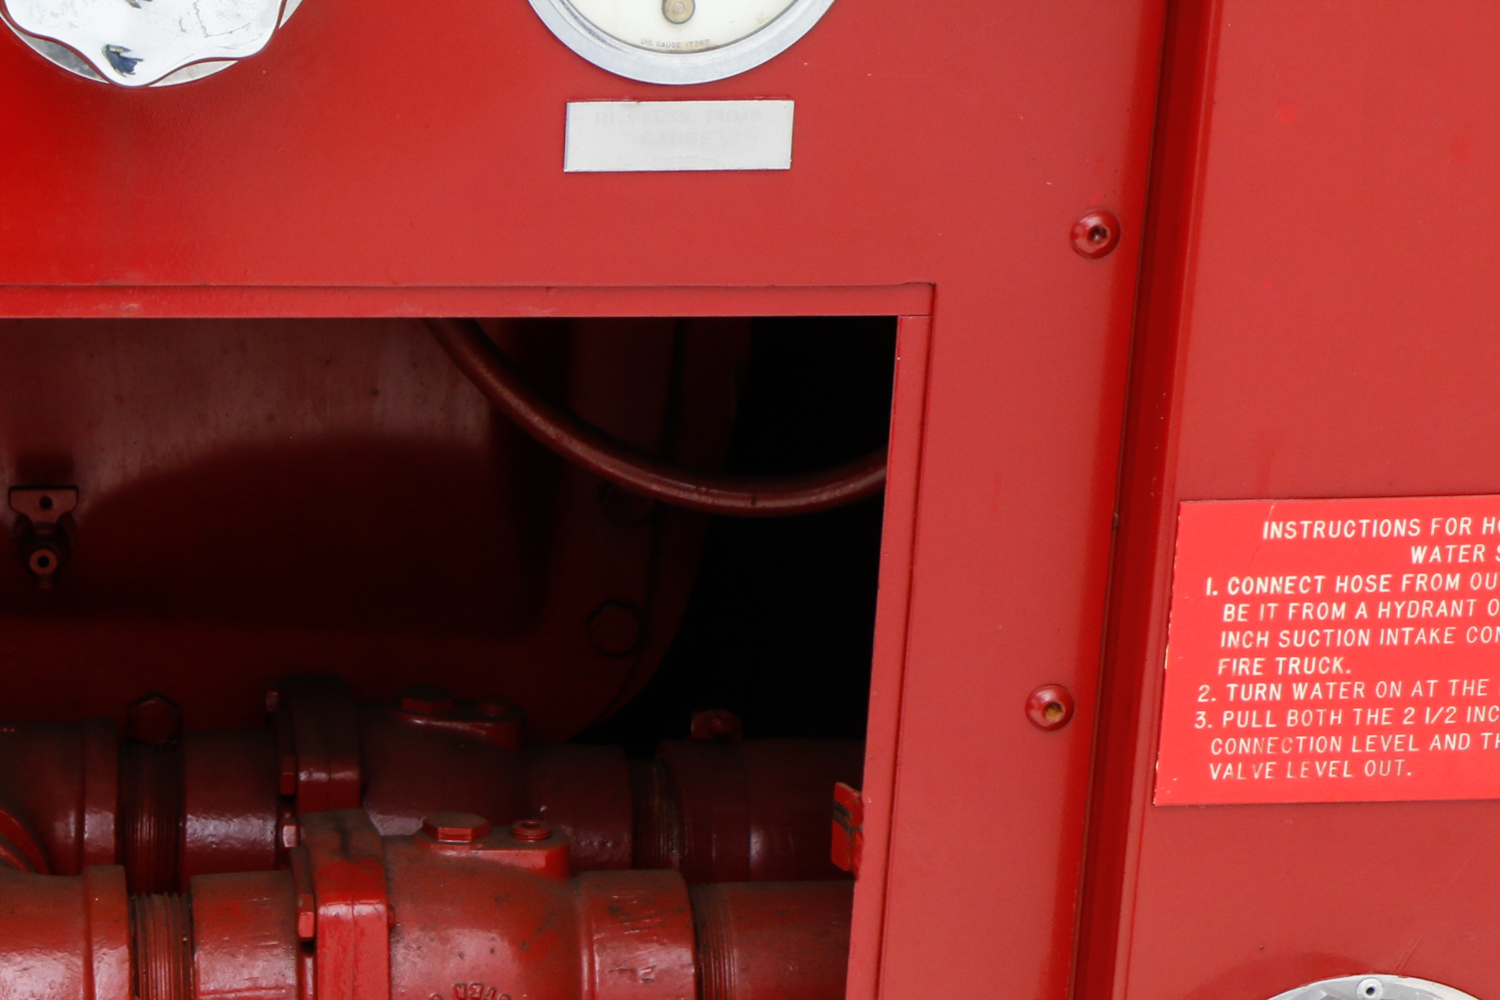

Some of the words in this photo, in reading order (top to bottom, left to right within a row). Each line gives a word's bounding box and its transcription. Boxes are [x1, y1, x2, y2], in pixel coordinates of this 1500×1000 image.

[656, 40, 681, 49] GAUGE
[706, 108, 763, 124] PUMP
[640, 131, 711, 147] GAUGE
[1262, 518, 1421, 540] INSTRUCTIONS
[1431, 517, 1473, 536] FOR
[1482, 516, 1500, 535] H
[1411, 544, 1486, 564] WATER
[1227, 575, 1327, 595] CONNECT
[1335, 574, 1393, 593] HOSE
[1401, 573, 1461, 592] FROM
[1470, 572, 1498, 590] OU
[1223, 603, 1250, 622] BE
[1259, 603, 1279, 621] IT
[1288, 602, 1347, 621] FROM
[1355, 601, 1368, 619] A
[1378, 599, 1477, 619] HYDRANT
[1220, 630, 1270, 649] INCH
[1278, 628, 1371, 648] SUCTION
[1380, 626, 1456, 646] INTAKE
[1218, 657, 1266, 676] FIRE
[1275, 656, 1352, 675] TRUCK.
[1197, 684, 1216, 702] 2.
[1226, 683, 1283, 701] TURN
[1292, 681, 1365, 700] WATER
[1375, 681, 1402, 698] ON
[1411, 679, 1439, 697] AT
[1448, 679, 1489, 696] THE
[1194, 711, 1213, 729] 3.
[1222, 710, 1277, 728] PULL
[1286, 709, 1342, 727] BOTH
[1353, 707, 1394, 725] THE
[1403, 707, 1416, 725] 2
[1425, 706, 1457, 724] 1/2
[1466, 705, 1500, 723] INC
[1211, 736, 1342, 755] CONNECTION
[1351, 734, 1420, 753] LEVEL
[1429, 733, 1471, 751] AND
[1209, 761, 1277, 780] VALVE
[1286, 760, 1354, 779] LEVEL
[1364, 759, 1412, 777] OUT.
